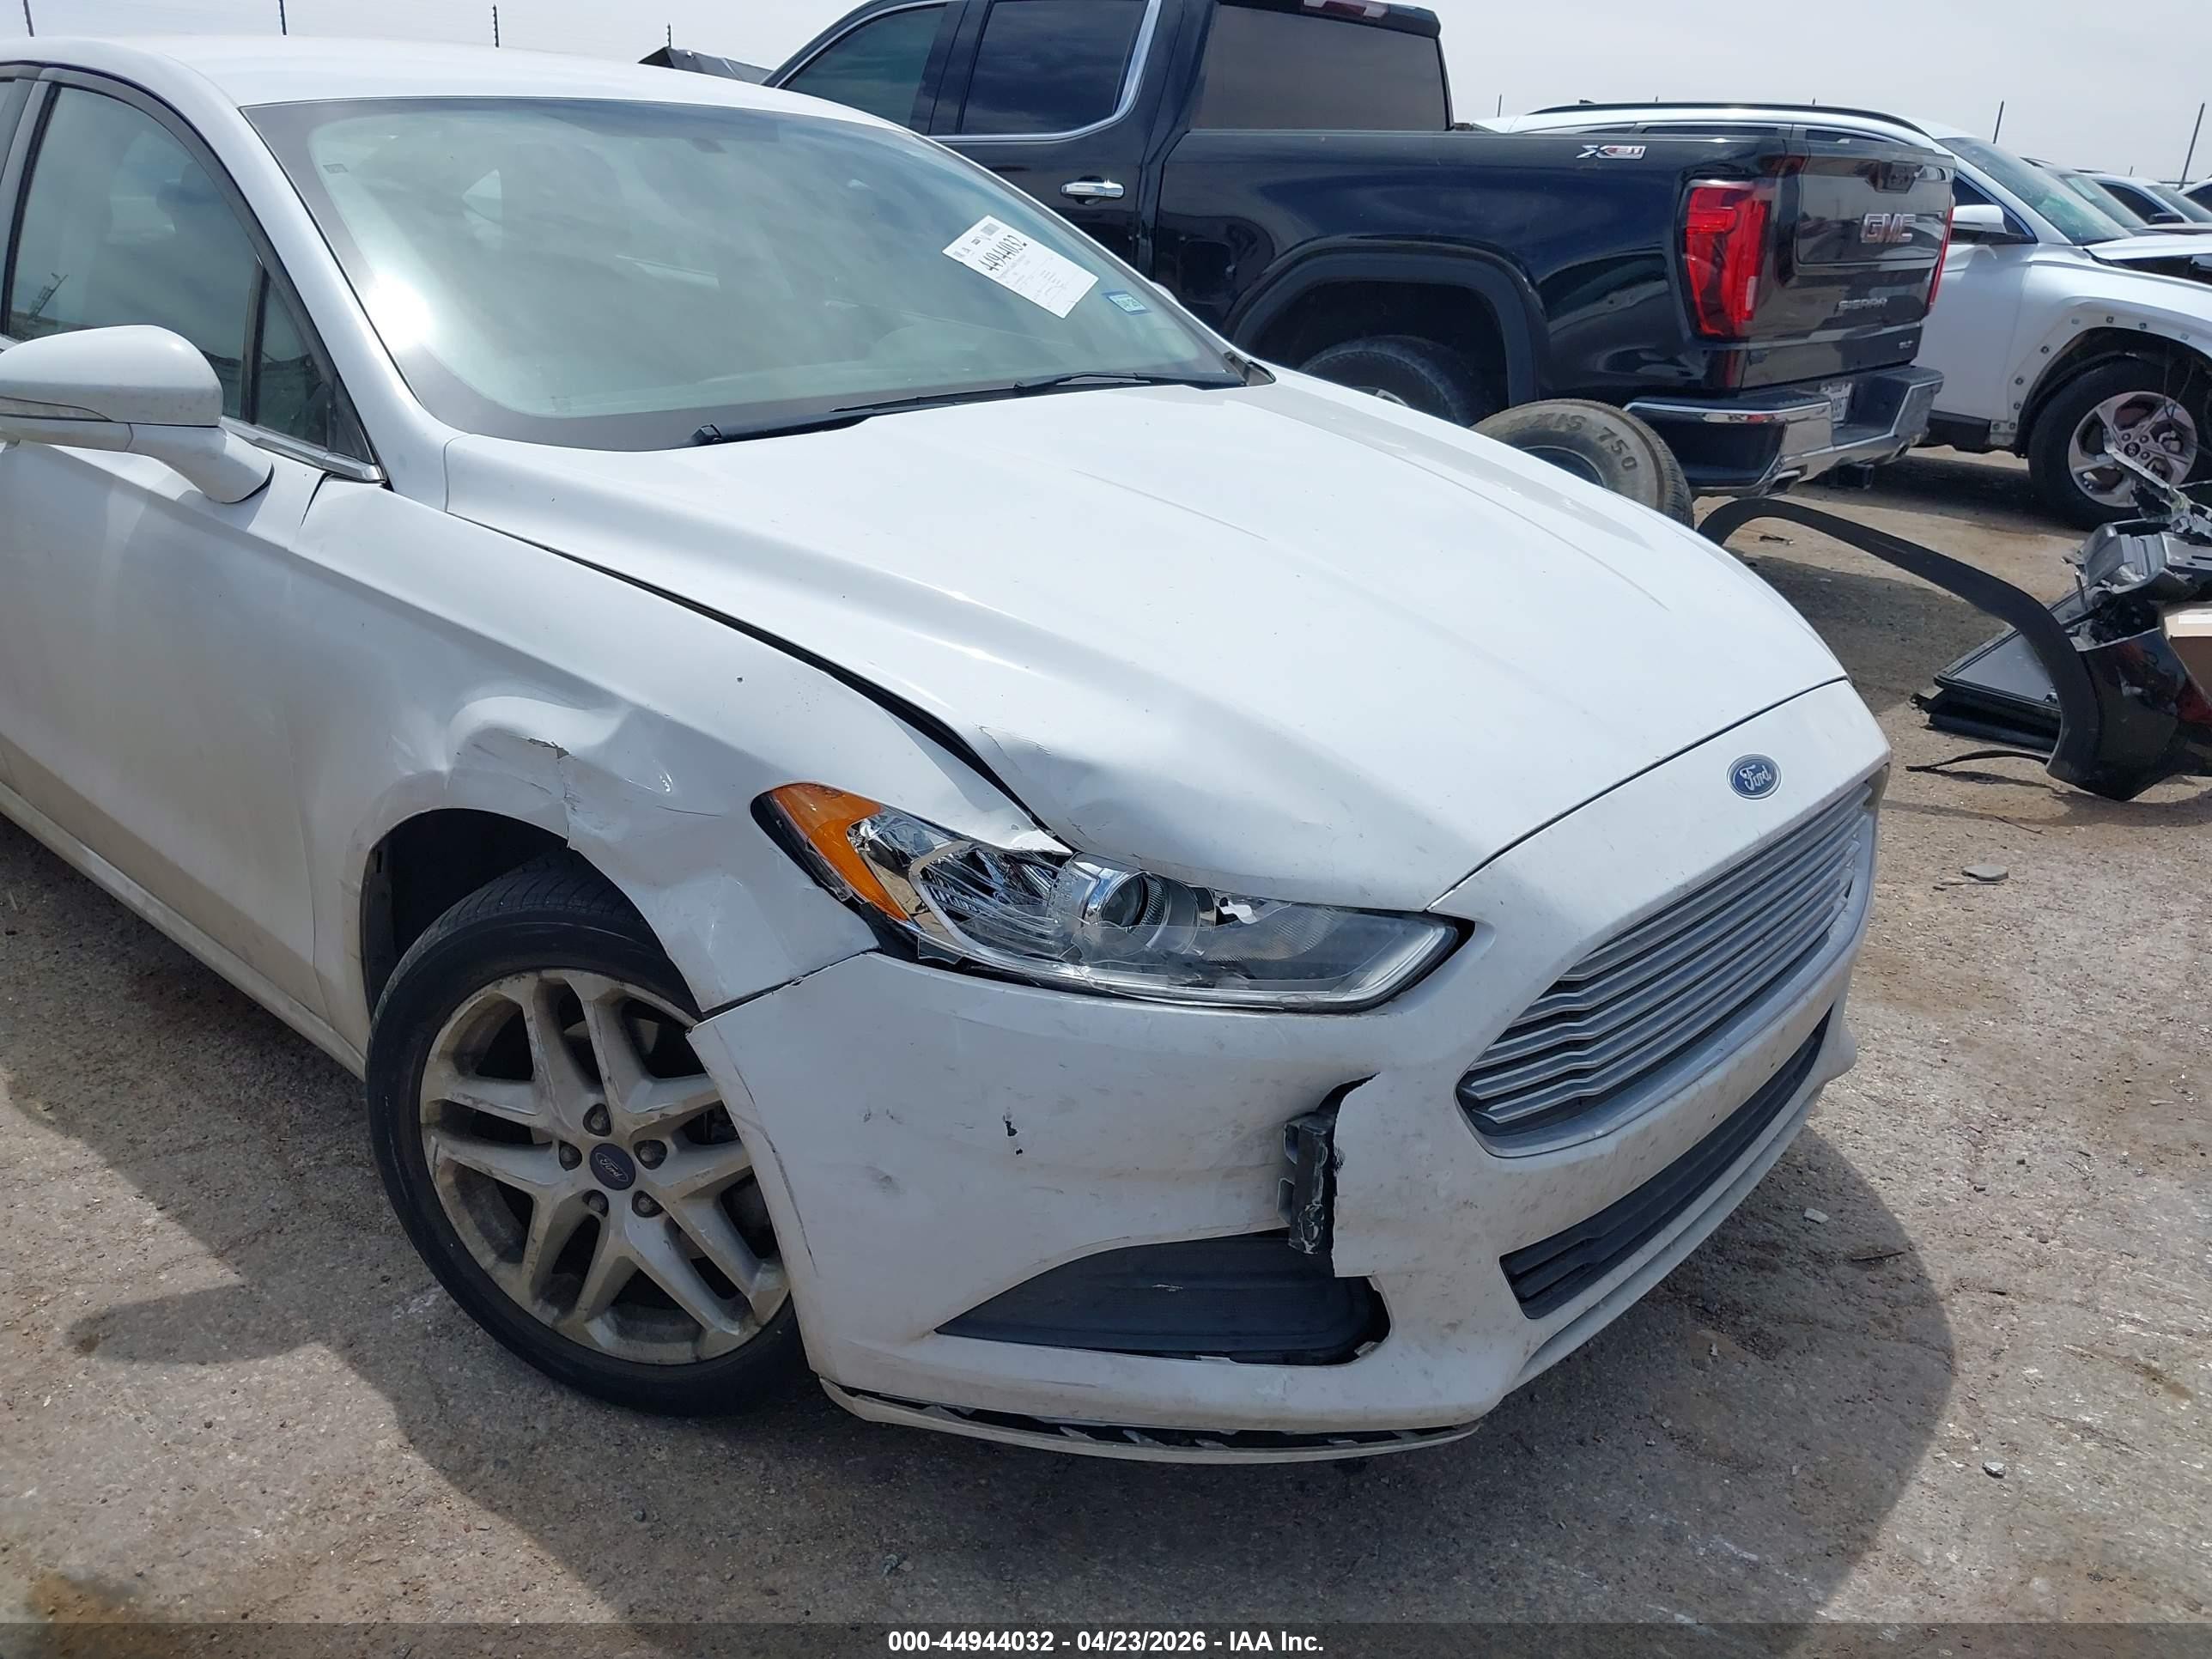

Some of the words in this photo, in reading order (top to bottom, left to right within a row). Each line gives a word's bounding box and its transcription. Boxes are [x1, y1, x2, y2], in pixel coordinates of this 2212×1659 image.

[1860, 213, 1917, 243] GMC
[977, 234, 1028, 272] 44944032
[1838, 297, 1888, 310] SIERRA
[1598, 425, 1639, 471] 750
[1739, 763, 1772, 791] Ford
